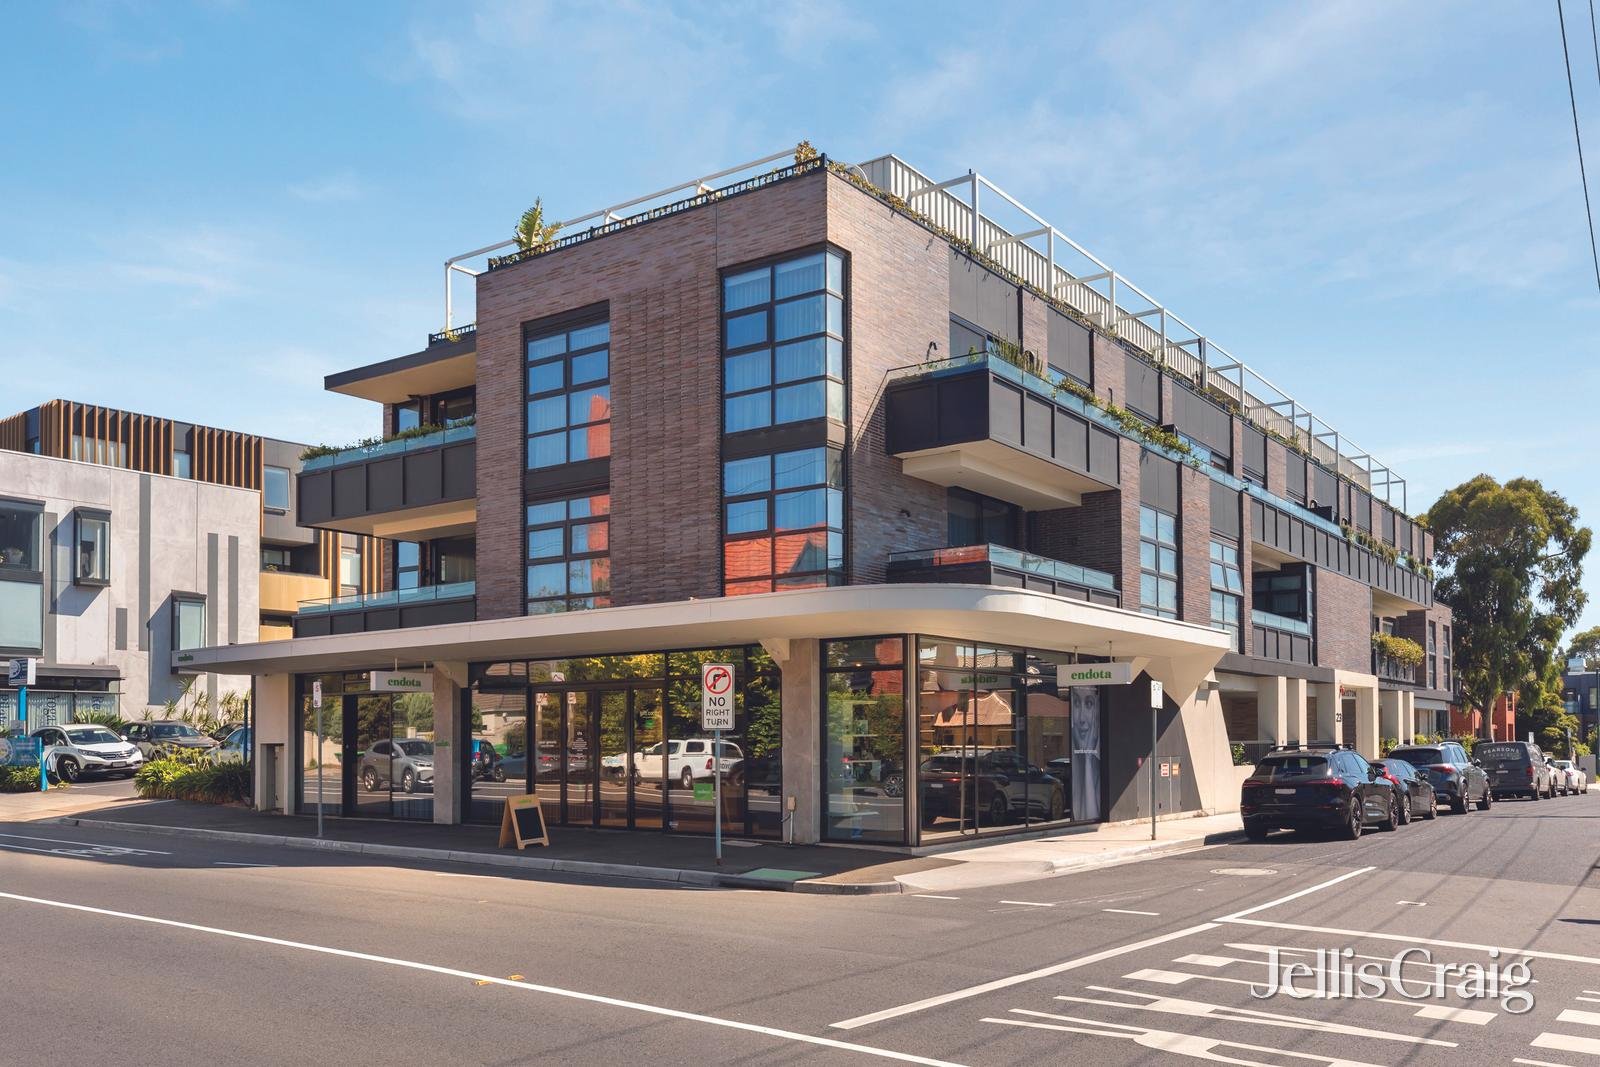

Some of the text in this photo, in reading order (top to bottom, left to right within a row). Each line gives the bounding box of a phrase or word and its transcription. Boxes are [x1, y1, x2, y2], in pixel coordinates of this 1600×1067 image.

[1071, 668, 1112, 681] endota
[388, 676, 422, 688] endota
[709, 696, 726, 707] NO
[705, 709, 730, 717] RIGHT
[1336, 712, 1342, 723] 23
[706, 718, 729, 726] TURN
